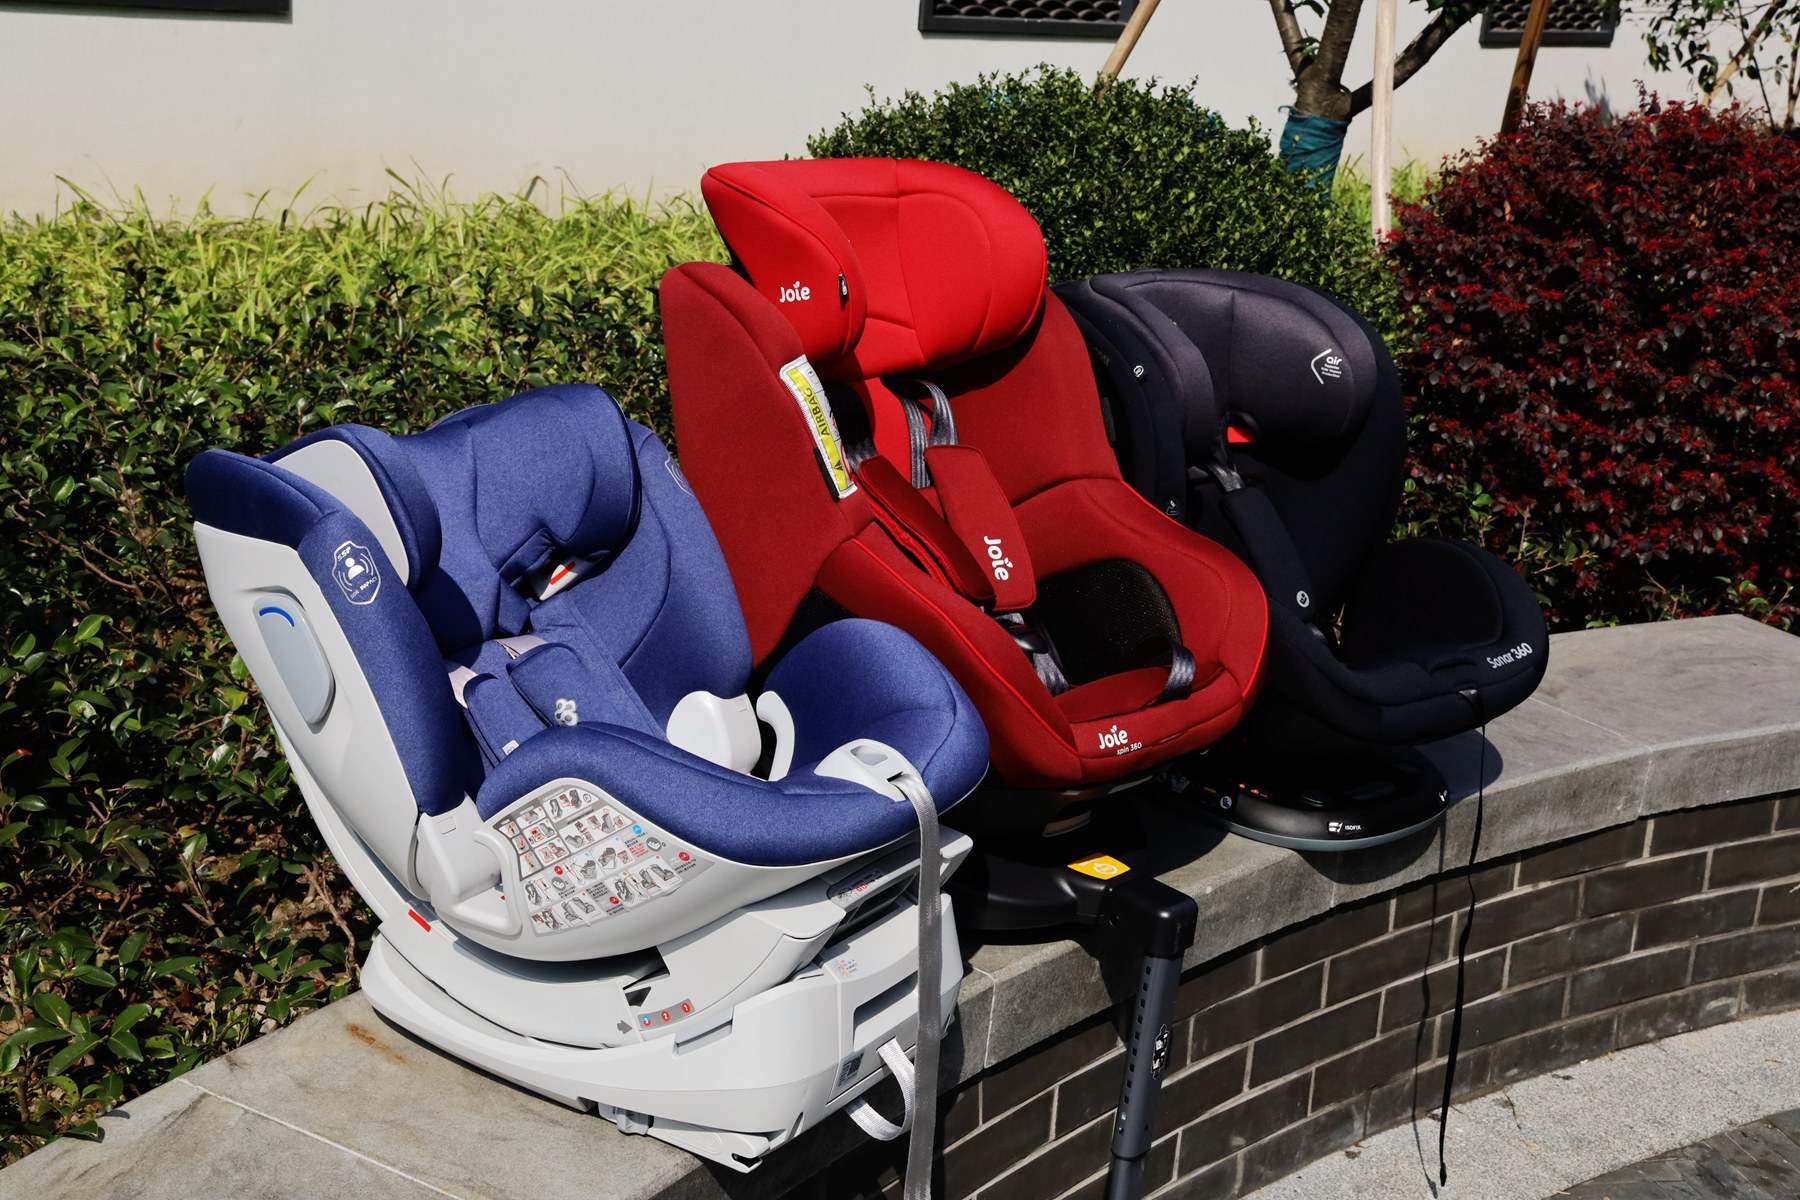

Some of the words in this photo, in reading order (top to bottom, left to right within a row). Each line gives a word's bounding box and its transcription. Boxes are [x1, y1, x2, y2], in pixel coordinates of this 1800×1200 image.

[779, 280, 811, 303] Joie
[1326, 356, 1343, 366] air
[804, 387, 831, 436] AIRBAG
[983, 535, 1014, 581] Joie
[1486, 652, 1515, 669] Sonar
[1510, 642, 1533, 659] 360
[1098, 724, 1129, 750] Joie
[1130, 742, 1143, 752] 360
